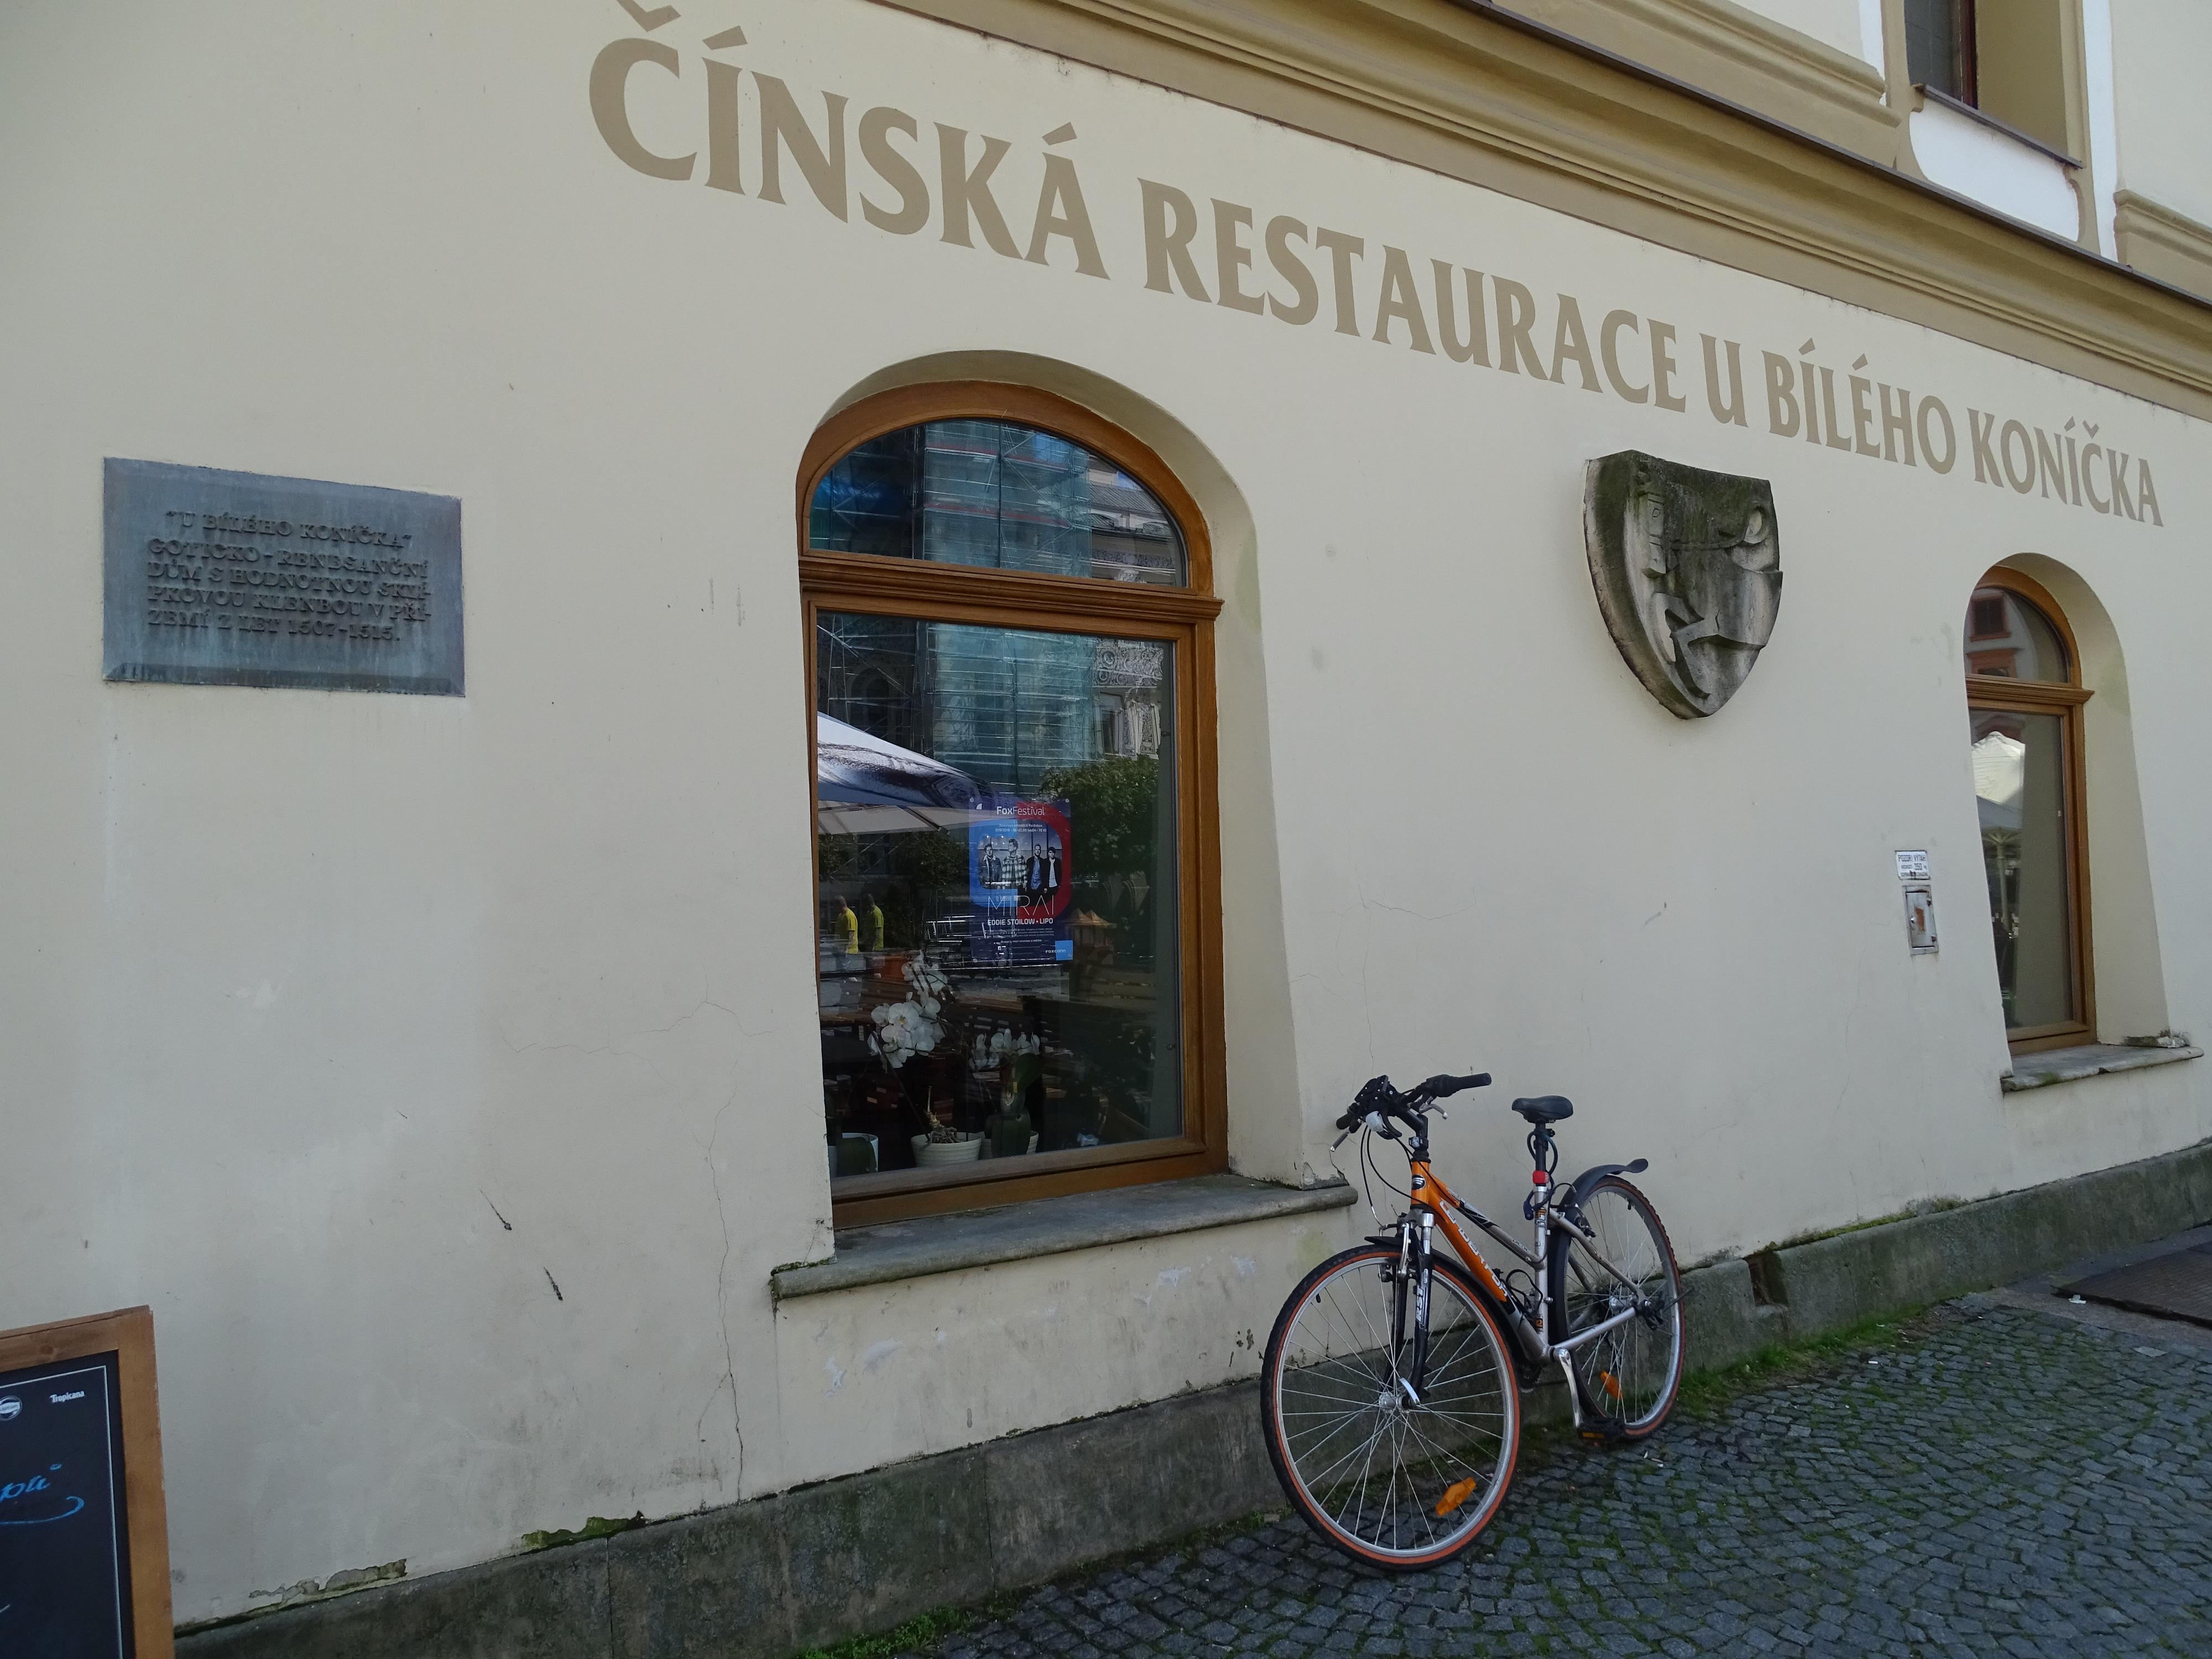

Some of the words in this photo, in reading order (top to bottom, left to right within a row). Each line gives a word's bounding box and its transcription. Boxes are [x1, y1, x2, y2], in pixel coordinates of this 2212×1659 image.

[588, 0, 1111, 281] ČÍNSKÁ
[1136, 176, 1687, 414] RESTAURACE
[1698, 332, 1749, 429] U
[1761, 337, 1957, 475] BÍLÉHO
[1965, 415, 2164, 528] KONÍČKA
[202, 512, 293, 536] BÍLÉHO
[149, 538, 260, 562] GOTICKO
[278, 550, 429, 578] RENESANČNÍ
[148, 559, 201, 582] DŮM
[208, 567, 224, 582] S
[230, 569, 372, 594] HODNOTNOU
[148, 586, 246, 607] PKOVOU
[253, 594, 362, 616] KLENBOU
[368, 603, 384, 618] V
[148, 609, 208, 628] ZEMÍ
[217, 613, 232, 630] Z
[238, 615, 280, 633] LET
[997, 806, 1045, 816] FoxFestival
[987, 895, 1054, 917] MIRAI
[1415, 1284, 1424, 1322] RST
[49, 1391, 85, 1403] Tropicana
